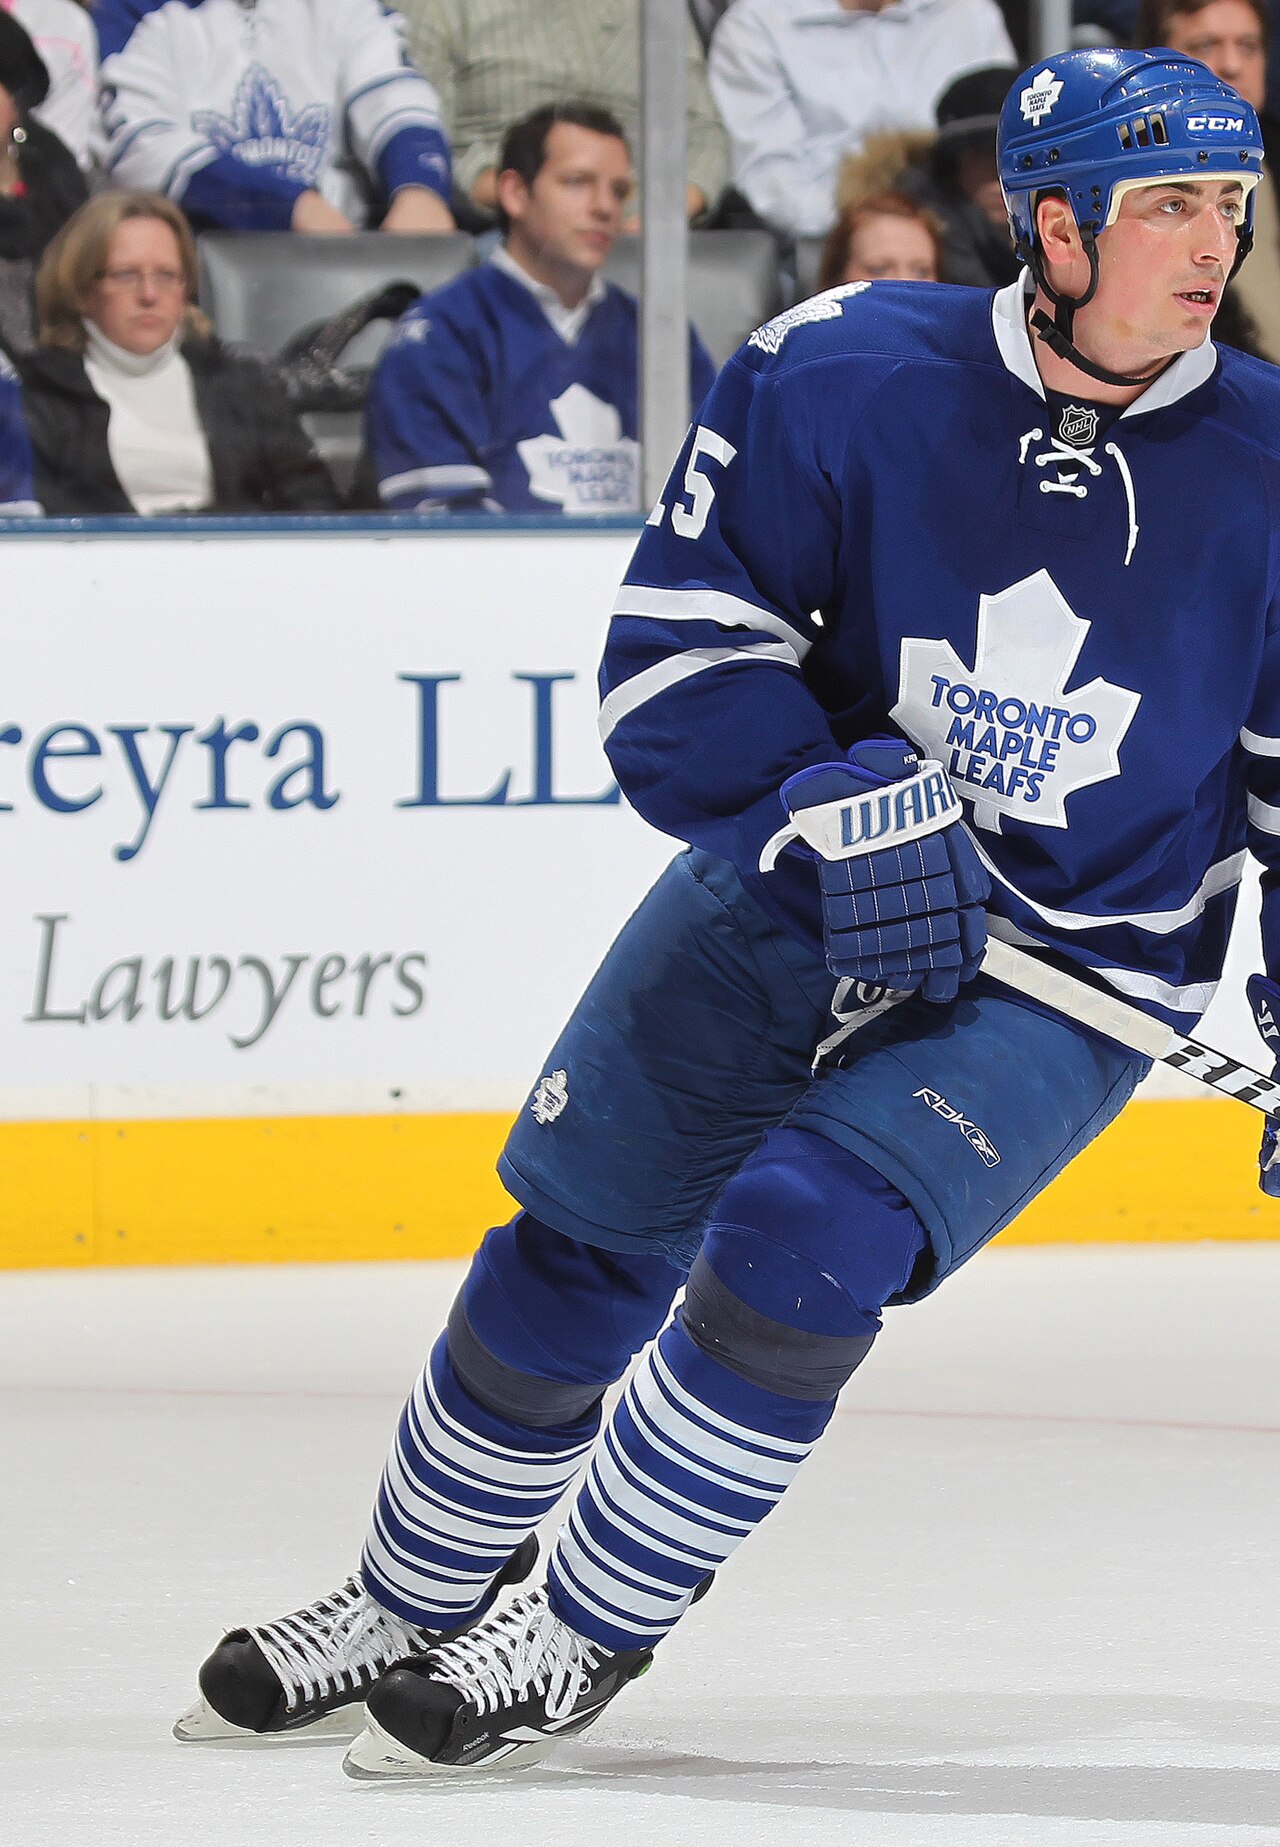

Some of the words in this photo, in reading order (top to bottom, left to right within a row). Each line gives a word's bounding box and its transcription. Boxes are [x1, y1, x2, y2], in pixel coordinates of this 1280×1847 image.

[1185, 117, 1243, 131] CCM
[1067, 419, 1090, 434] NHL
[931, 674, 1097, 744] TORONTO
[945, 716, 1061, 773] MAPLE
[949, 748, 1046, 803] LEAFS
[839, 769, 958, 847] WAR
[23, 912, 428, 1049] Lawyers
[462, 1731, 491, 1752] Reebok
